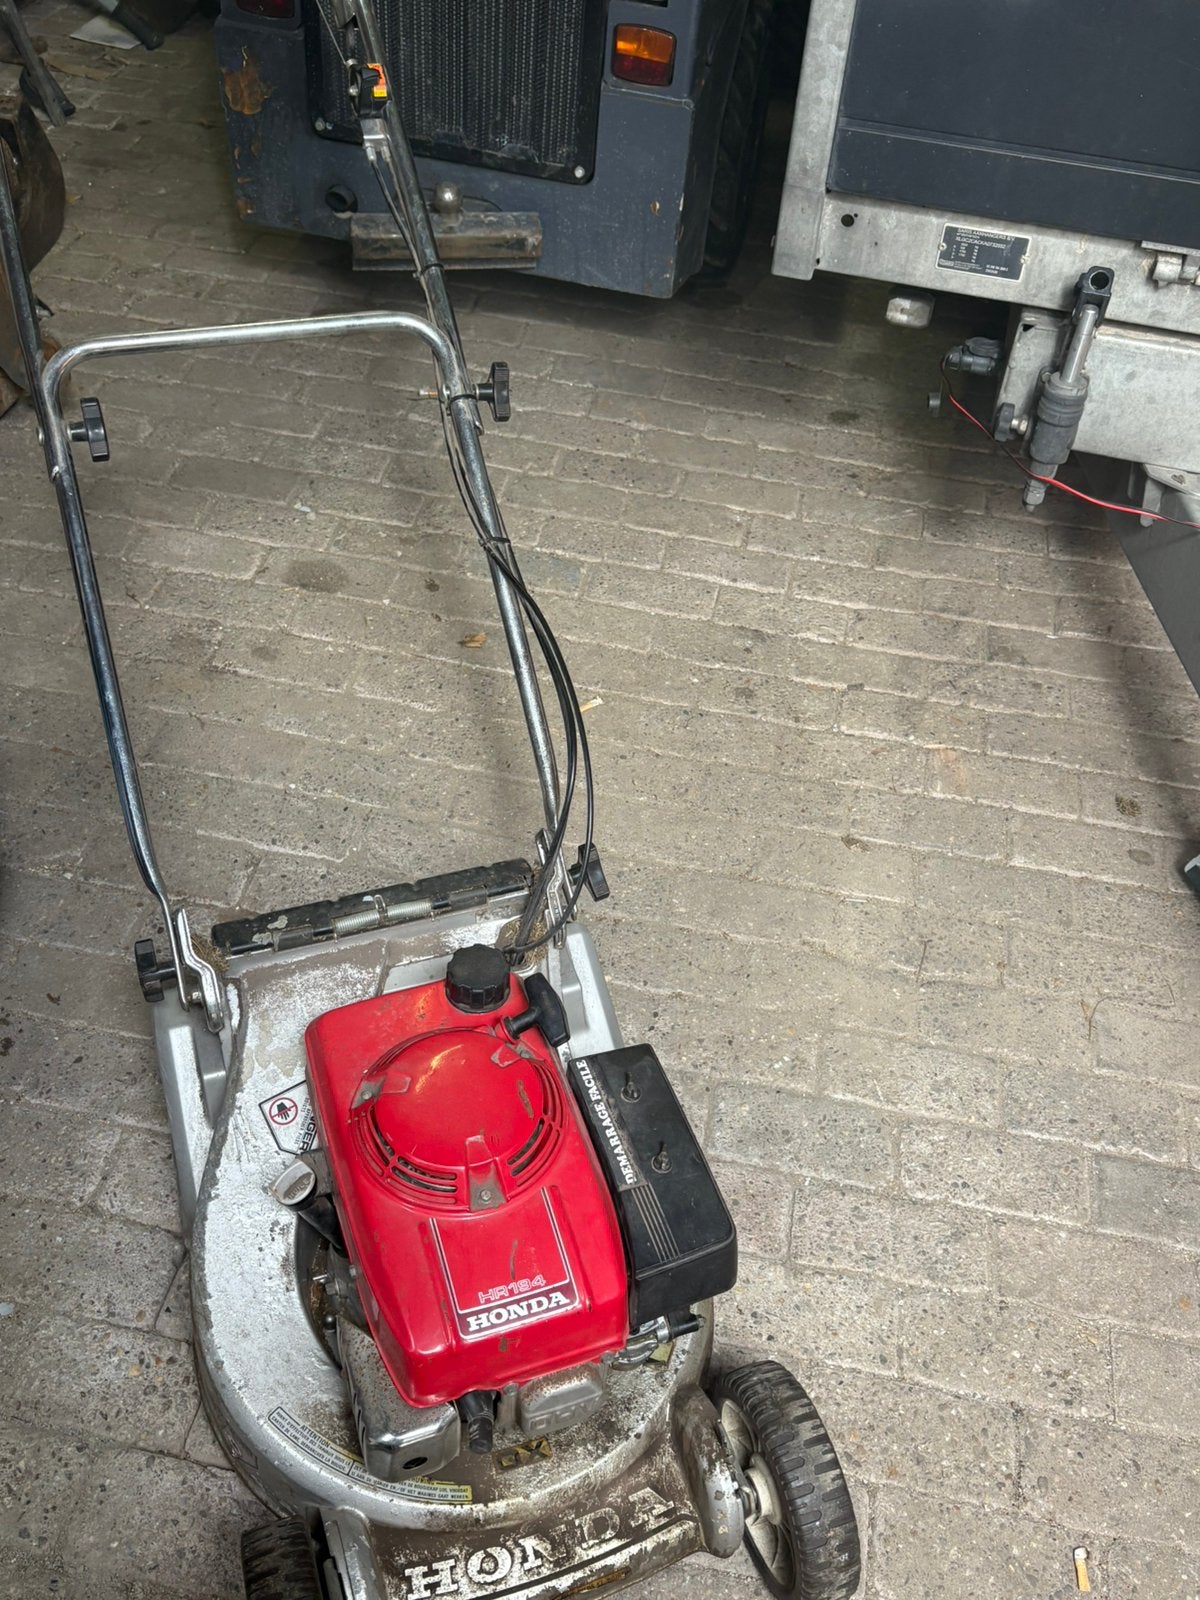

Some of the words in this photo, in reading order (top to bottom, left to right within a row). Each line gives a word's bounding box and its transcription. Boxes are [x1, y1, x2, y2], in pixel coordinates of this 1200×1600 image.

[576, 1060, 601, 1101] FACILE
[594, 1102, 637, 1184] DEMARRAGE
[466, 1291, 570, 1332] HONDA
[300, 1424, 330, 1448] ATTENTION
[405, 1487, 675, 1600] HONDA
